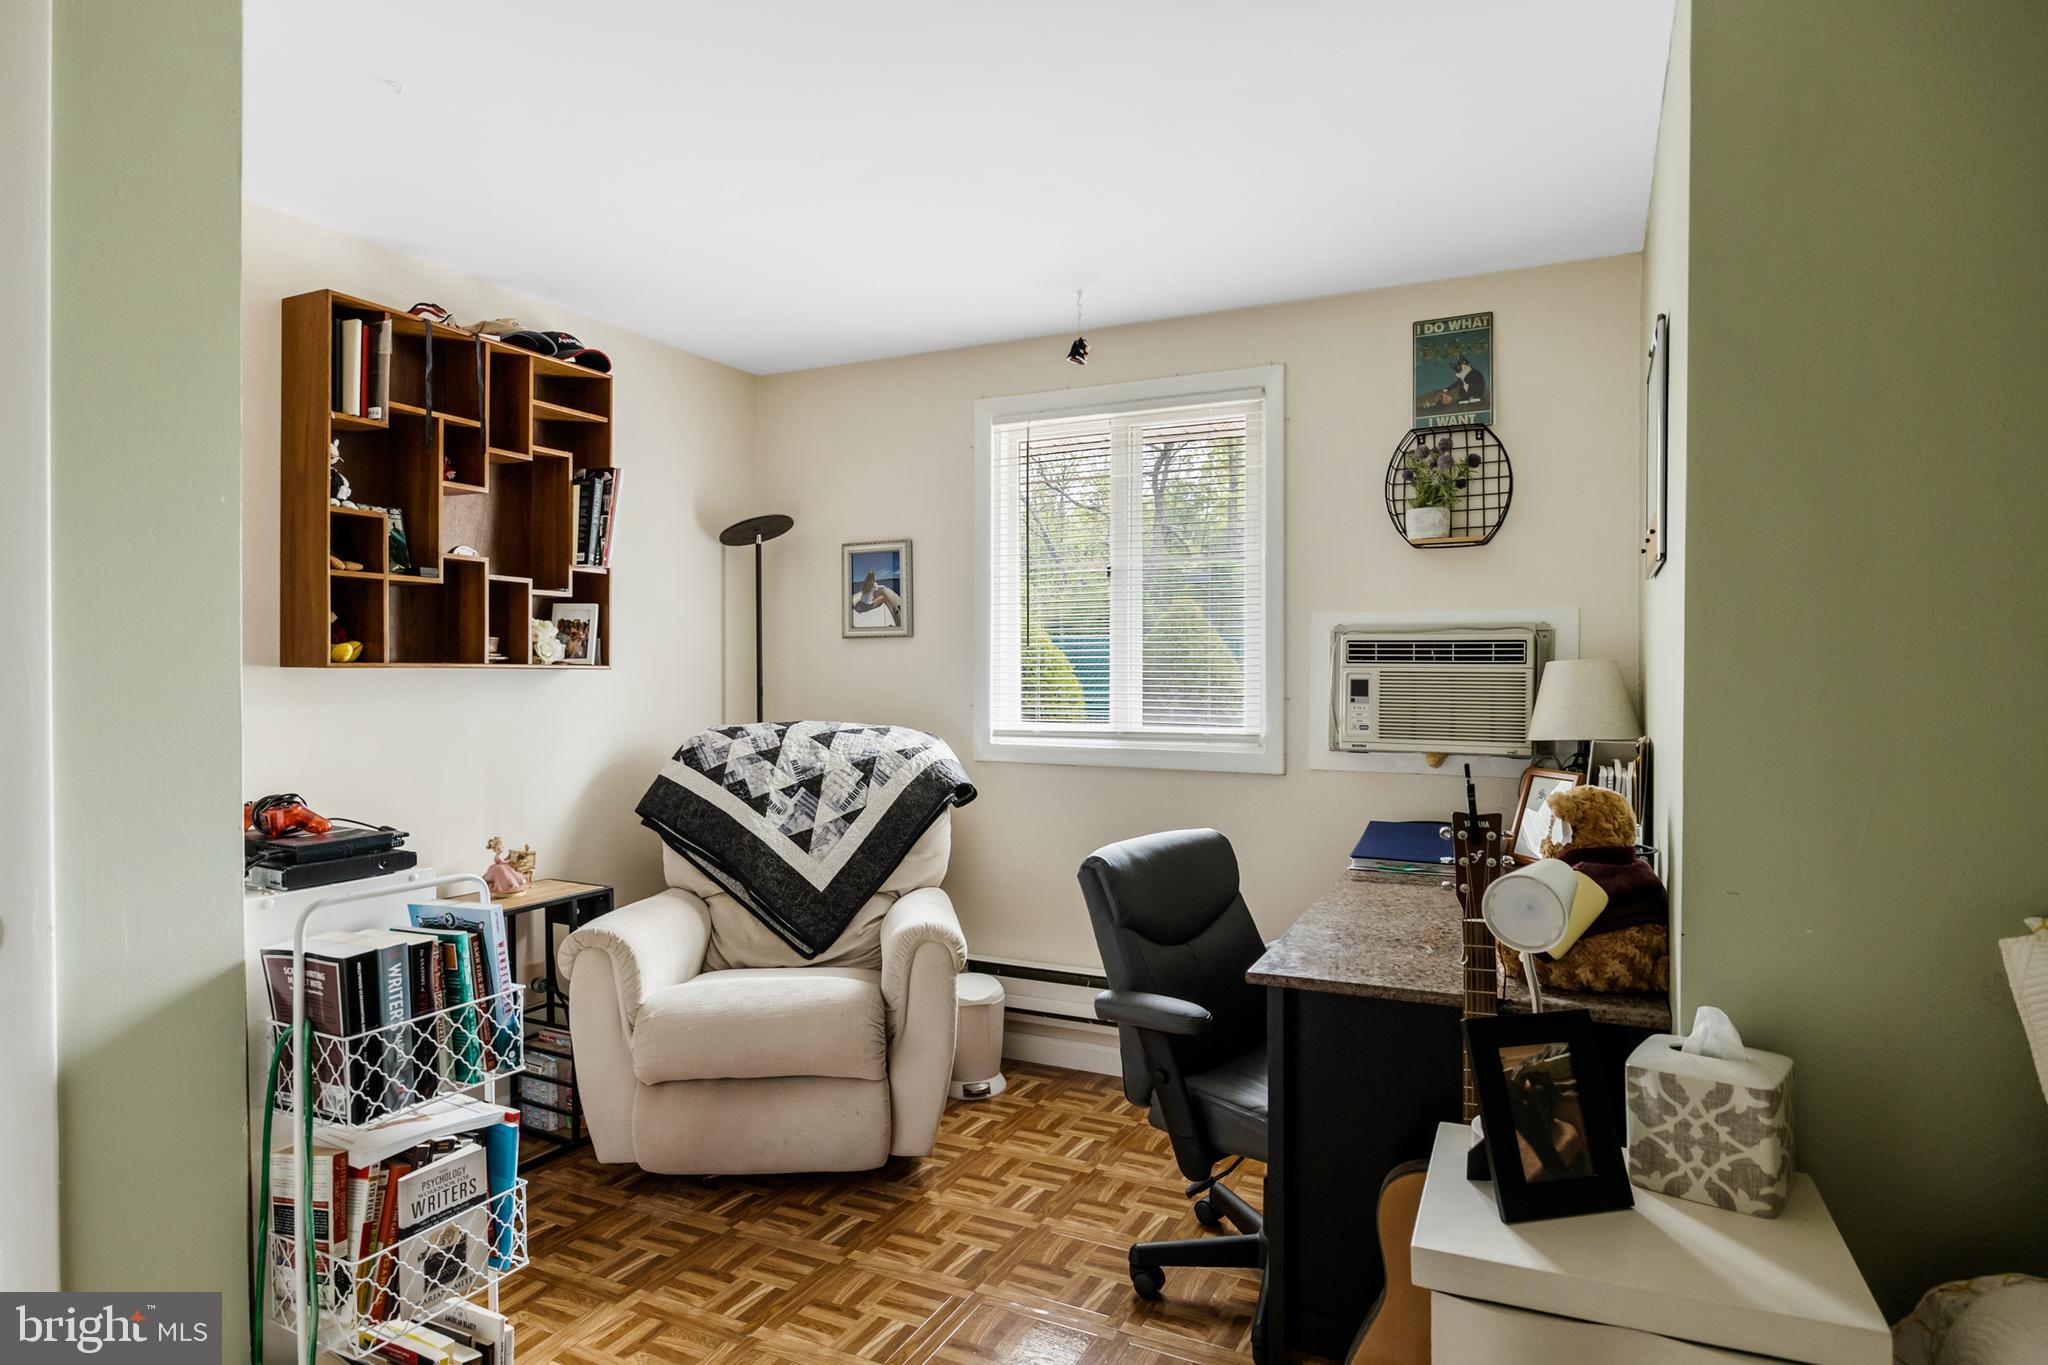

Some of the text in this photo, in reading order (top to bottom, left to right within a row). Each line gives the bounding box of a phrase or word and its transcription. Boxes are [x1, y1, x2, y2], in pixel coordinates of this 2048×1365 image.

[1424, 322, 1445, 334] DO
[1448, 316, 1489, 331] WHAT
[1437, 414, 1476, 426] WANT
[1464, 820, 1490, 828] YAAHA
[421, 1165, 466, 1191] PSYCHOLOGY
[366, 1182, 376, 1221] SYD FIELD
[411, 1178, 477, 1219] WRITERS
